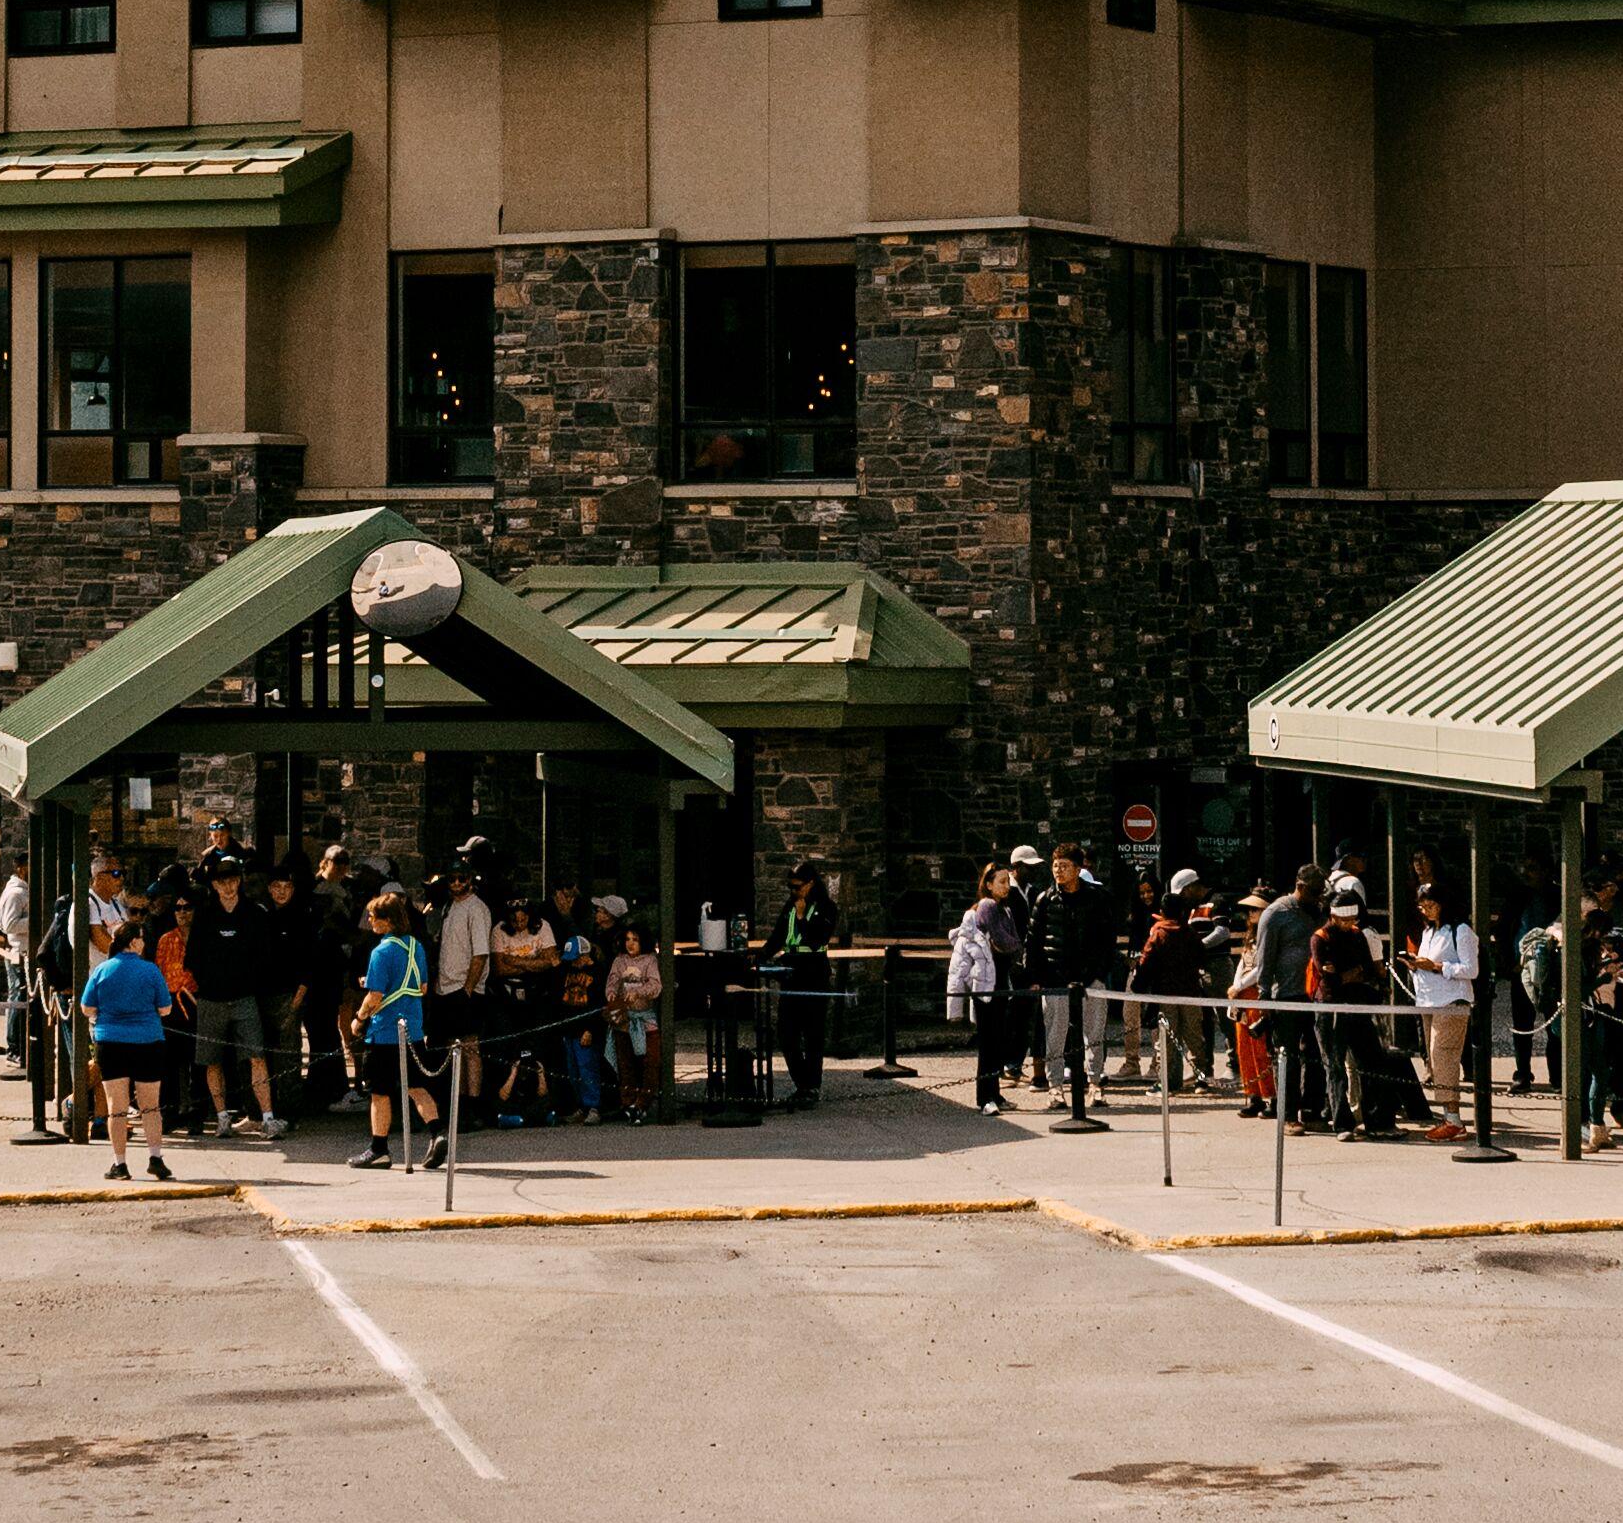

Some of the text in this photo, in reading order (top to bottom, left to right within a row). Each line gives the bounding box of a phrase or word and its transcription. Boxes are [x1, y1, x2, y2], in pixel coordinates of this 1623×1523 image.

[1271, 719, 1277, 744] C
[1118, 844, 1162, 852] NO ENTRY
